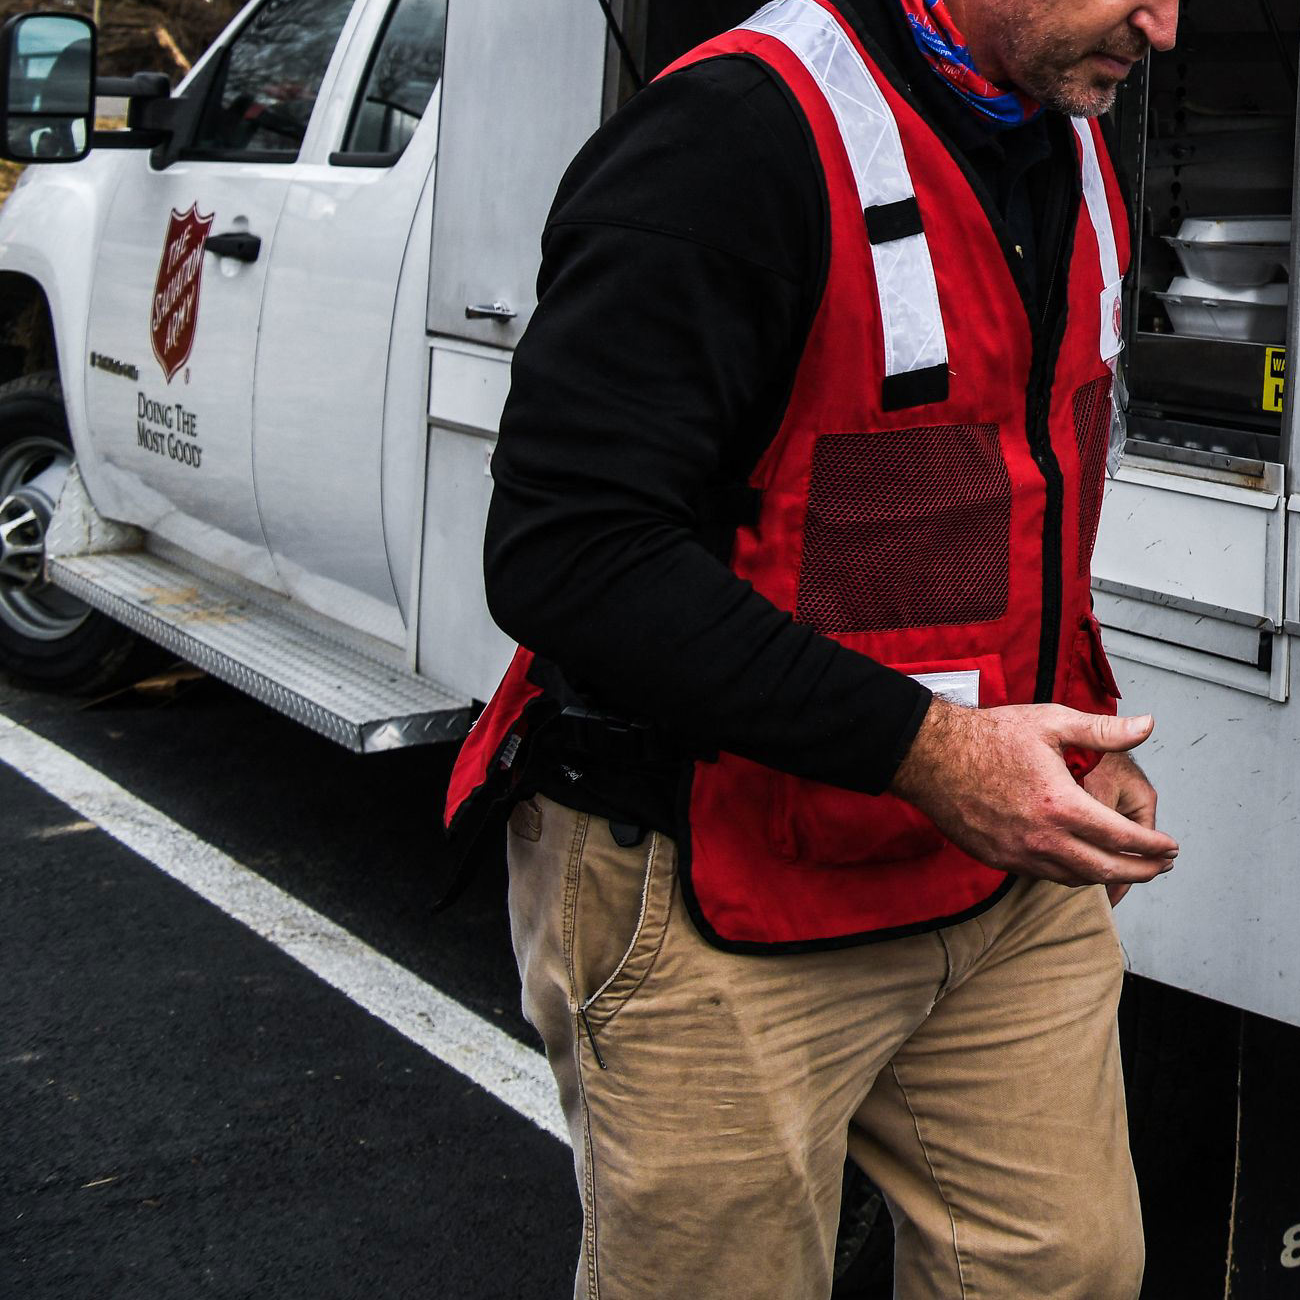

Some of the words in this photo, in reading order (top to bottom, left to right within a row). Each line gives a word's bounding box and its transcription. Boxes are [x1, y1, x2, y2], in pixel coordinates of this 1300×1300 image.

[152, 234, 205, 332] SALVATION
[166, 224, 192, 275] THE
[164, 284, 196, 356] ARMY
